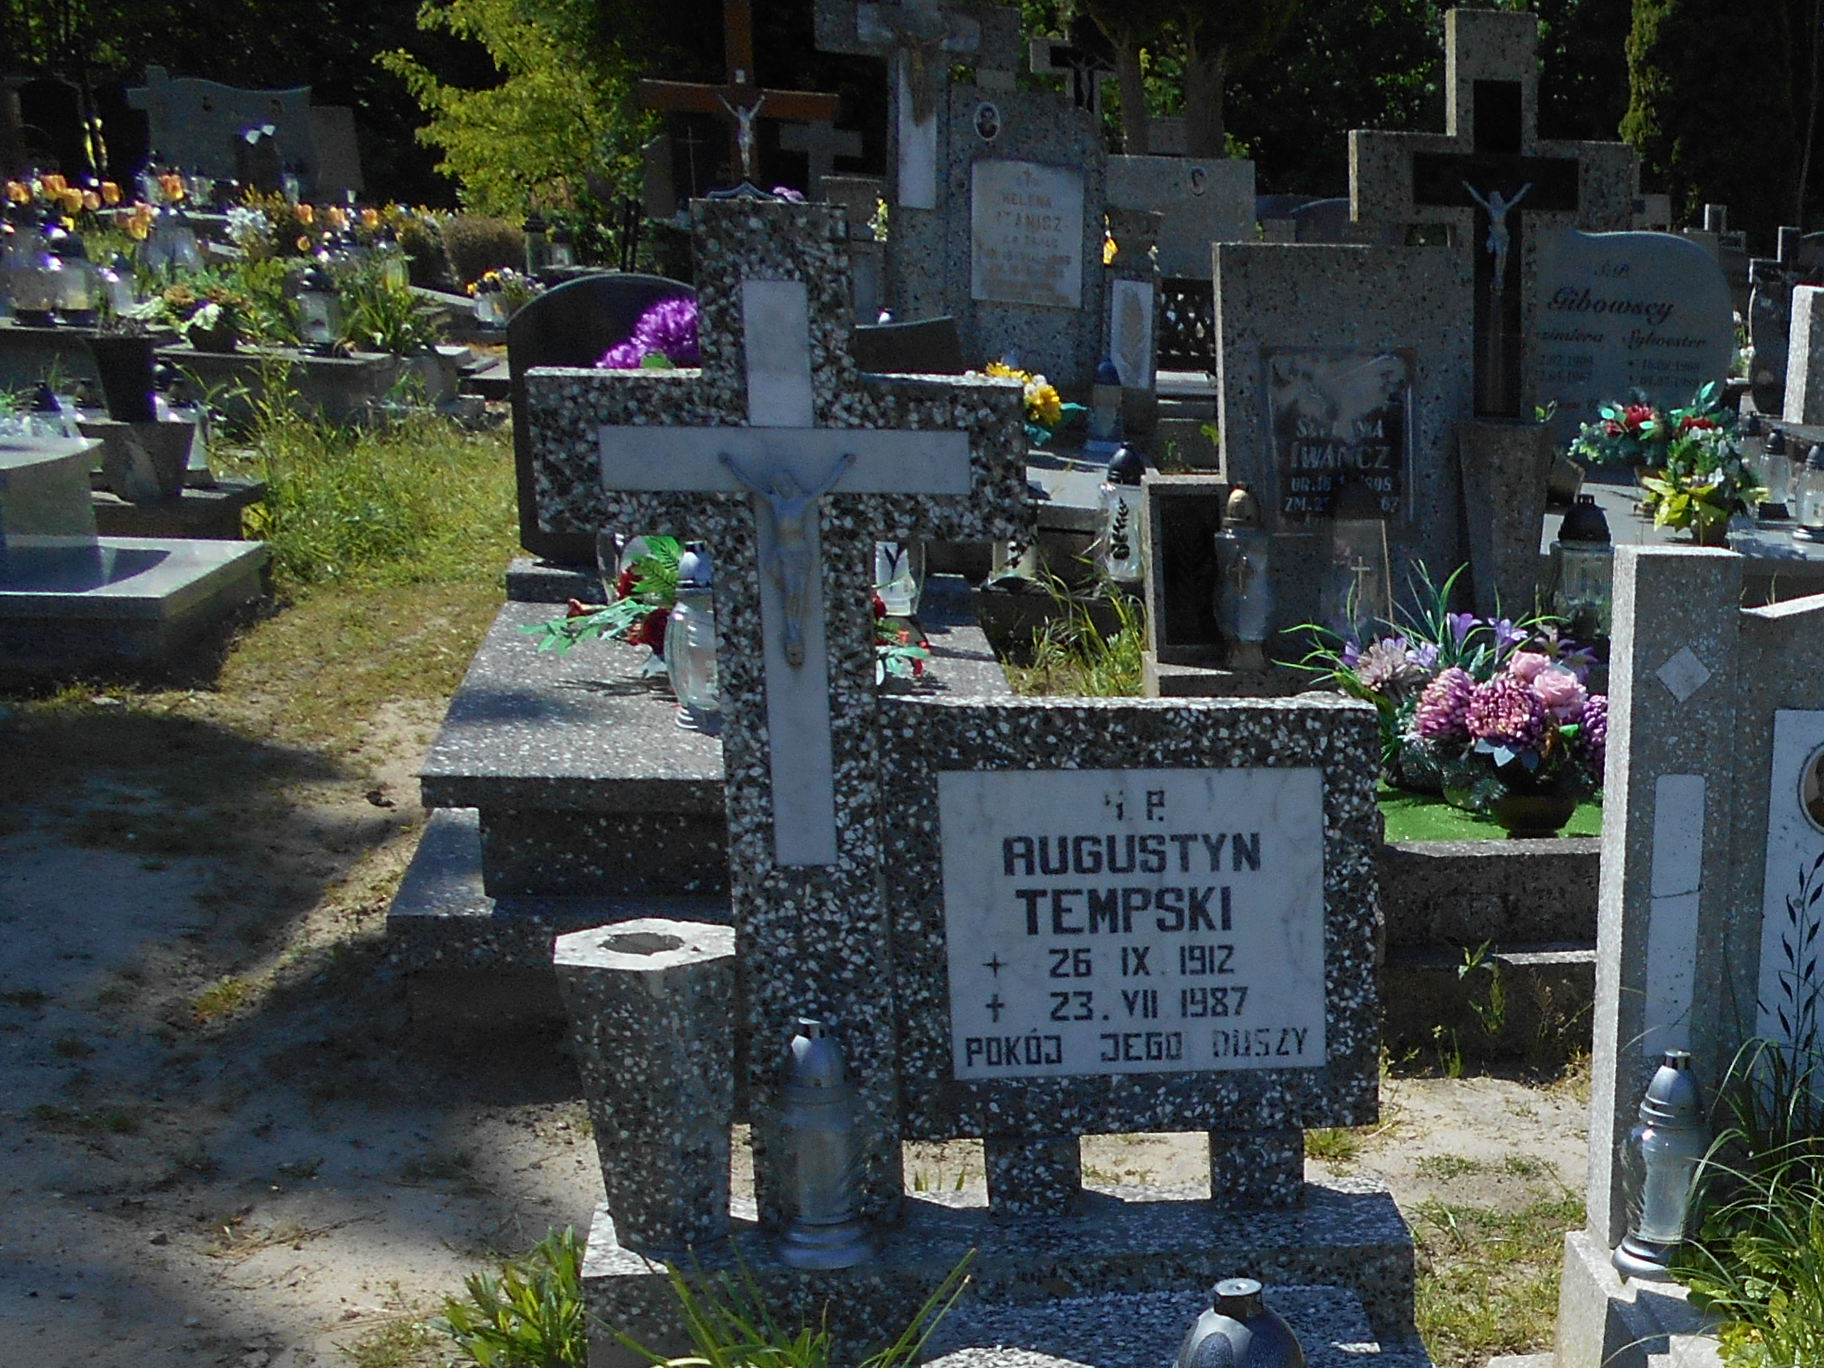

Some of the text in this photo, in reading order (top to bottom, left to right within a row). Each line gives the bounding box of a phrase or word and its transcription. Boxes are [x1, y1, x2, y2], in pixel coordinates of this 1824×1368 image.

[1547, 285, 1674, 326] Gibowscy
[1536, 329, 1707, 350] zimiera Sylwester
[1003, 832, 1261, 876] AUGUSTYN
[1016, 886, 1233, 936] TEMPSKI
[1048, 947, 1092, 978] 26
[1179, 944, 1235, 975] 1912
[1049, 986, 1249, 1022] 23. VII 1987
[965, 1027, 1309, 1067] POKÓJ JEGO DUSZY
